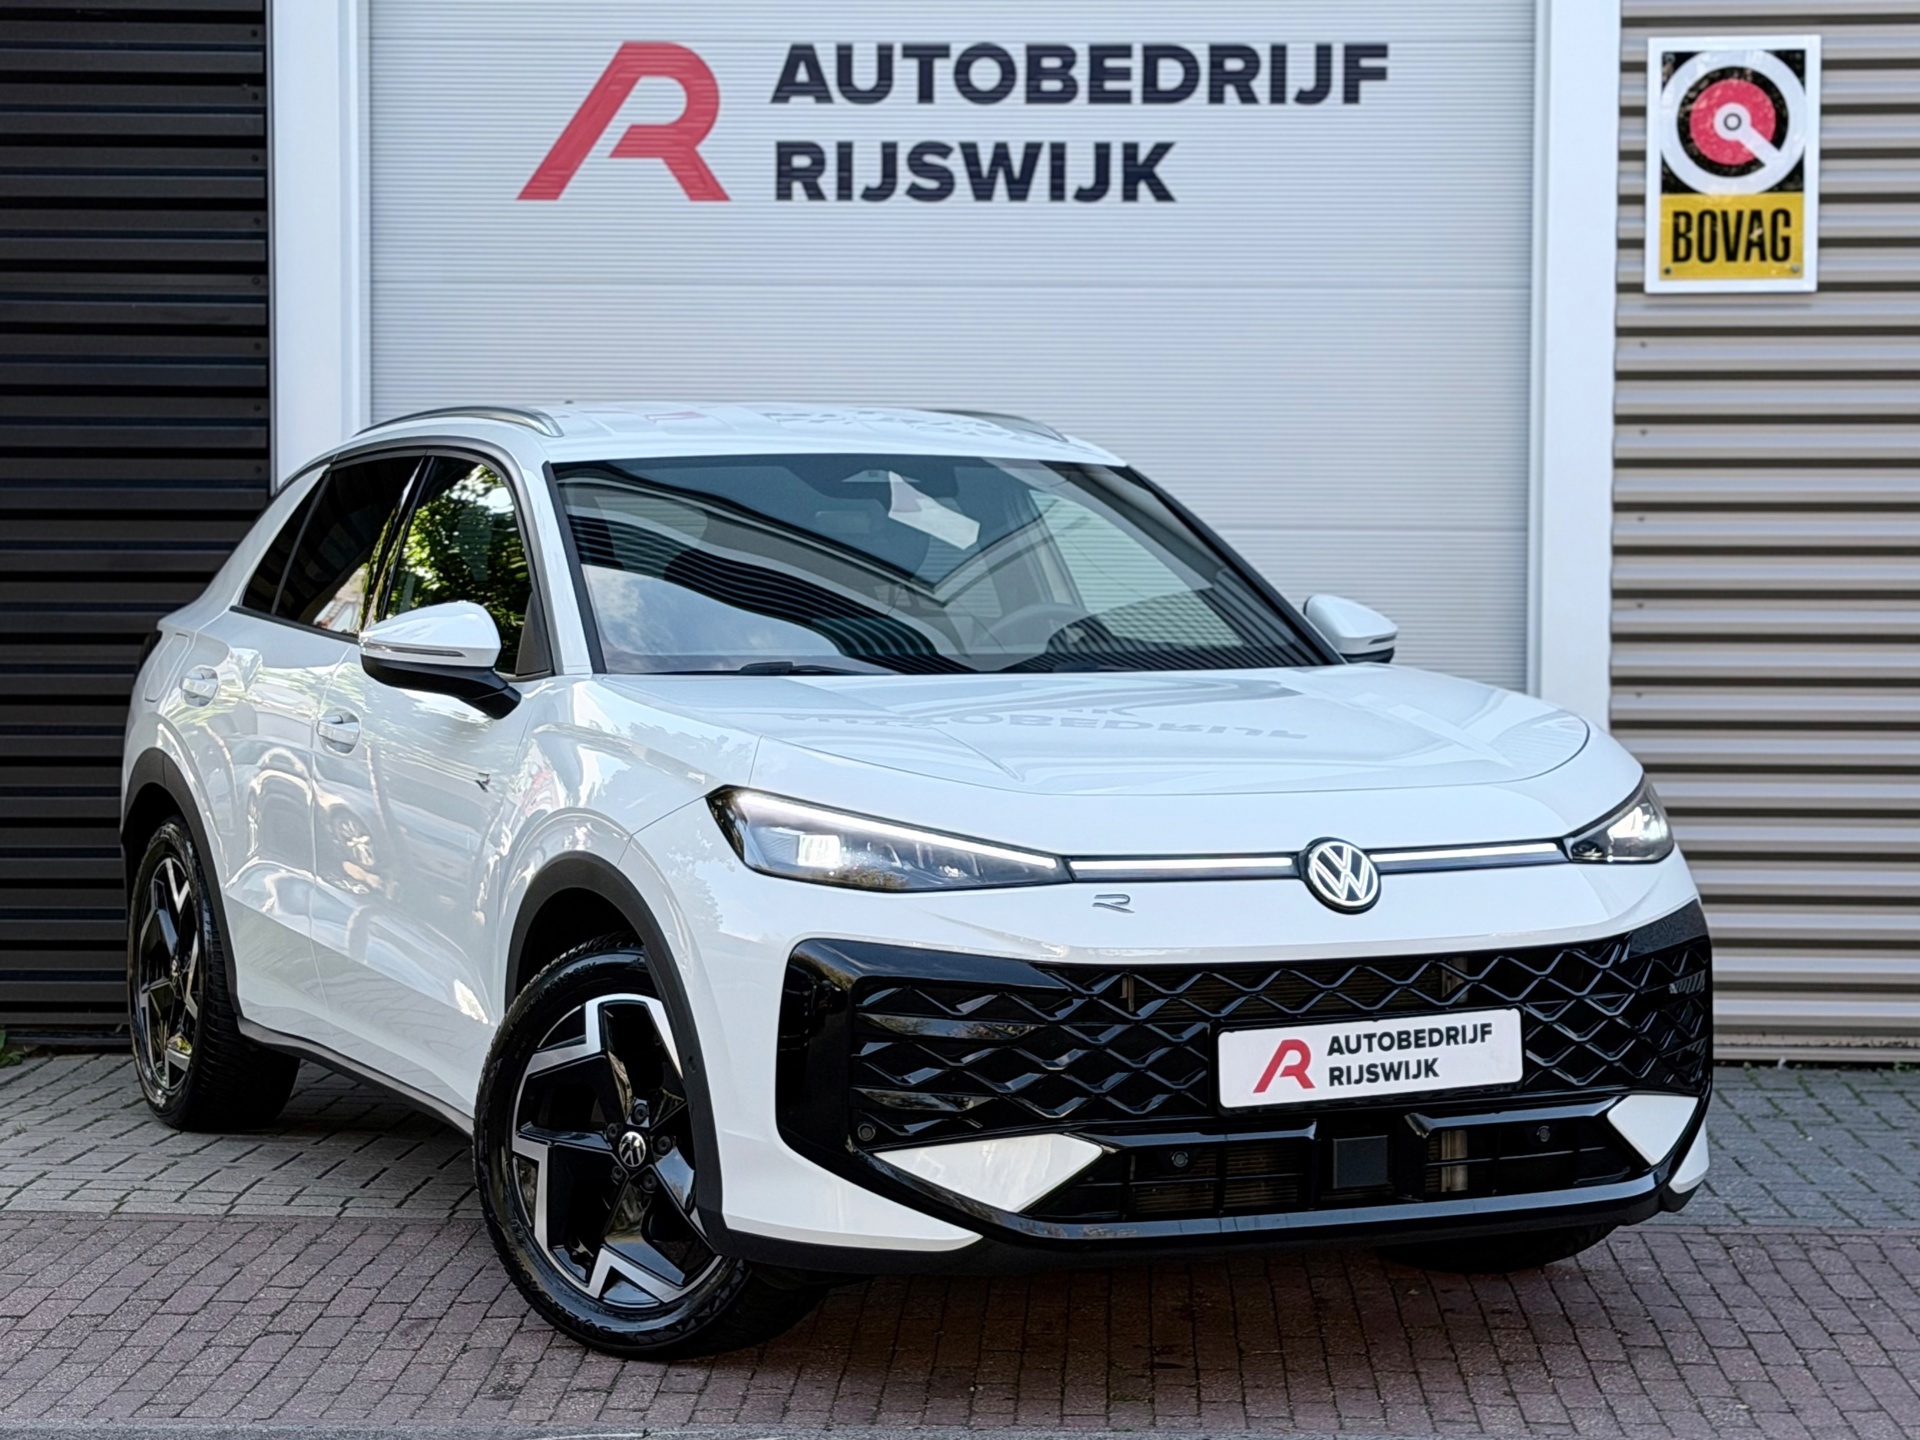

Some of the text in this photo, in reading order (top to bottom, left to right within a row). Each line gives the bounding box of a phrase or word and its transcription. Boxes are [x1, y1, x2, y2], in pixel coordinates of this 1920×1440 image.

[770, 42, 1389, 106] AUTOBEDRIJF
[775, 141, 1176, 203] RIJSWIJK
[1671, 208, 1792, 264] BOVAG
[1326, 1022, 1493, 1057] AUTOBEDRIJF
[1328, 1057, 1440, 1087] RIJSWIJK
